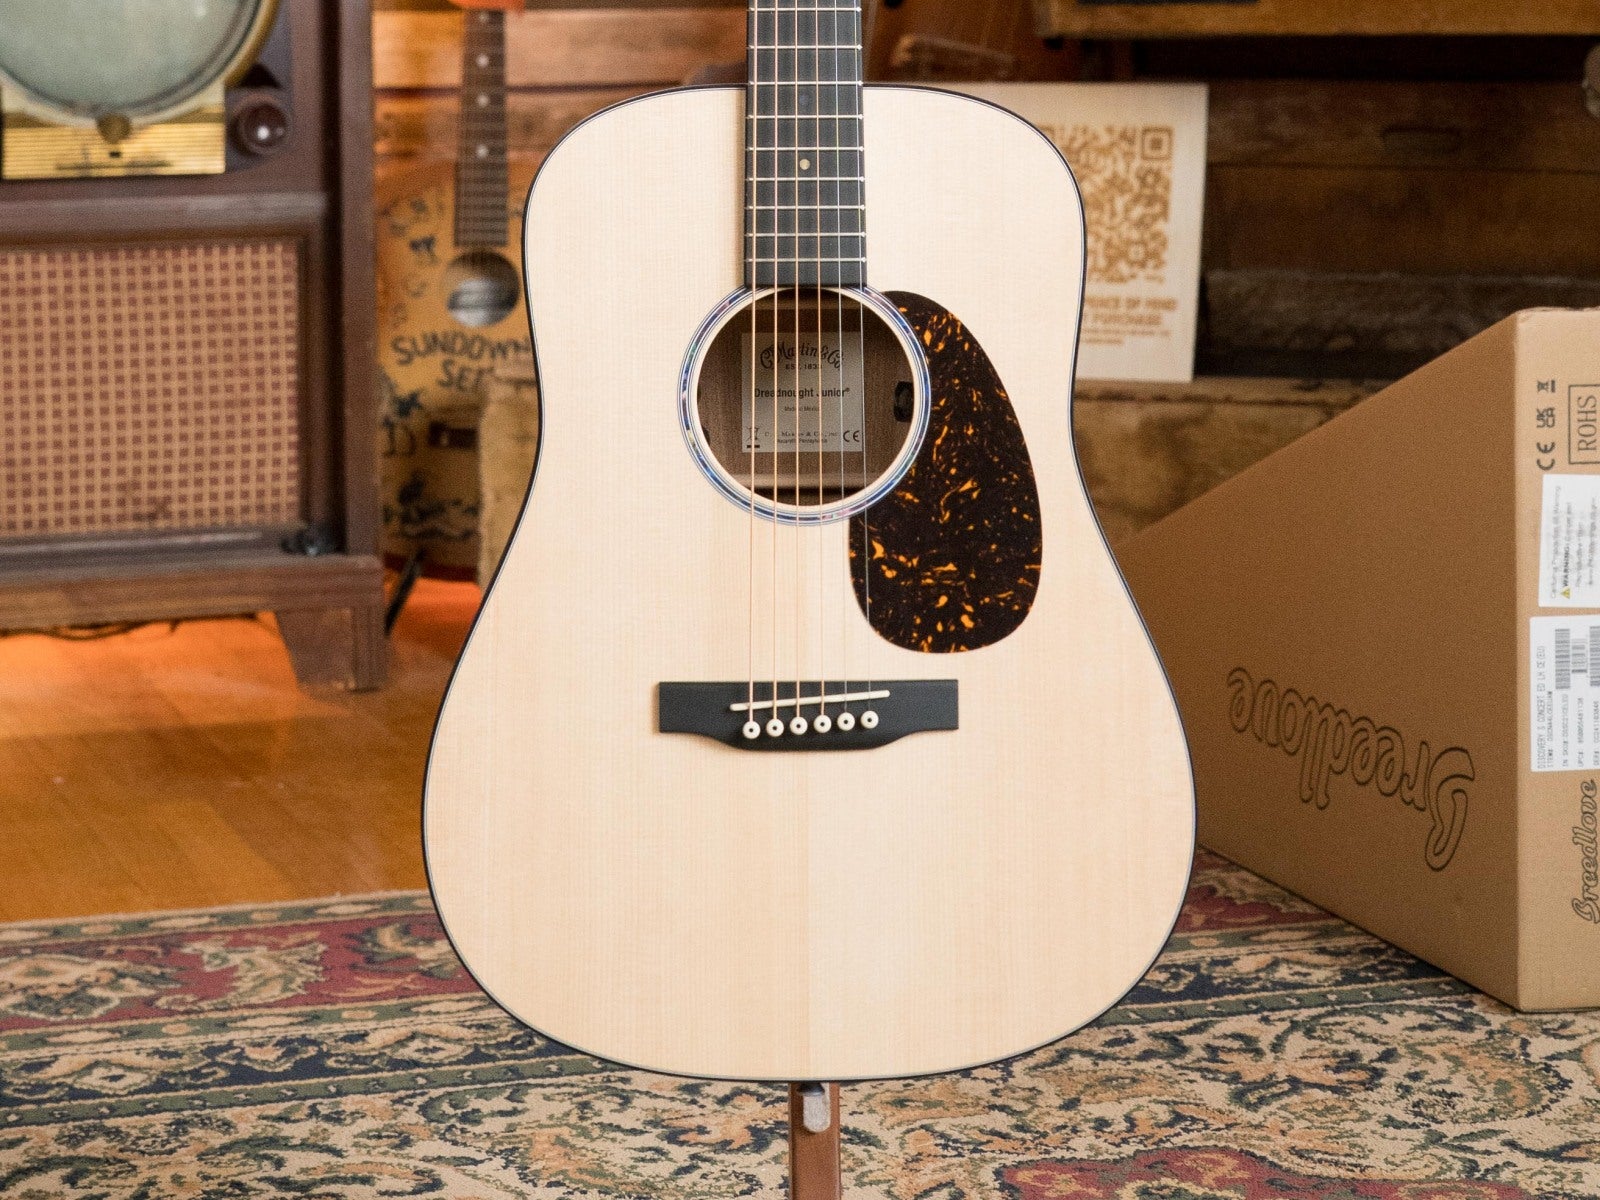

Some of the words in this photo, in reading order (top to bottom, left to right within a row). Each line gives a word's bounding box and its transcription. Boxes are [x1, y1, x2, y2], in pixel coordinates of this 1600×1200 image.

[1577, 394, 1598, 452] ROHS
[1537, 683, 1545, 692] ED
[1537, 695, 1545, 722] CONCERT
[1228, 666, 1475, 872] Breedlove
[1537, 735, 1546, 769] DISCOVERY
[1571, 778, 1600, 924] Breedlove
